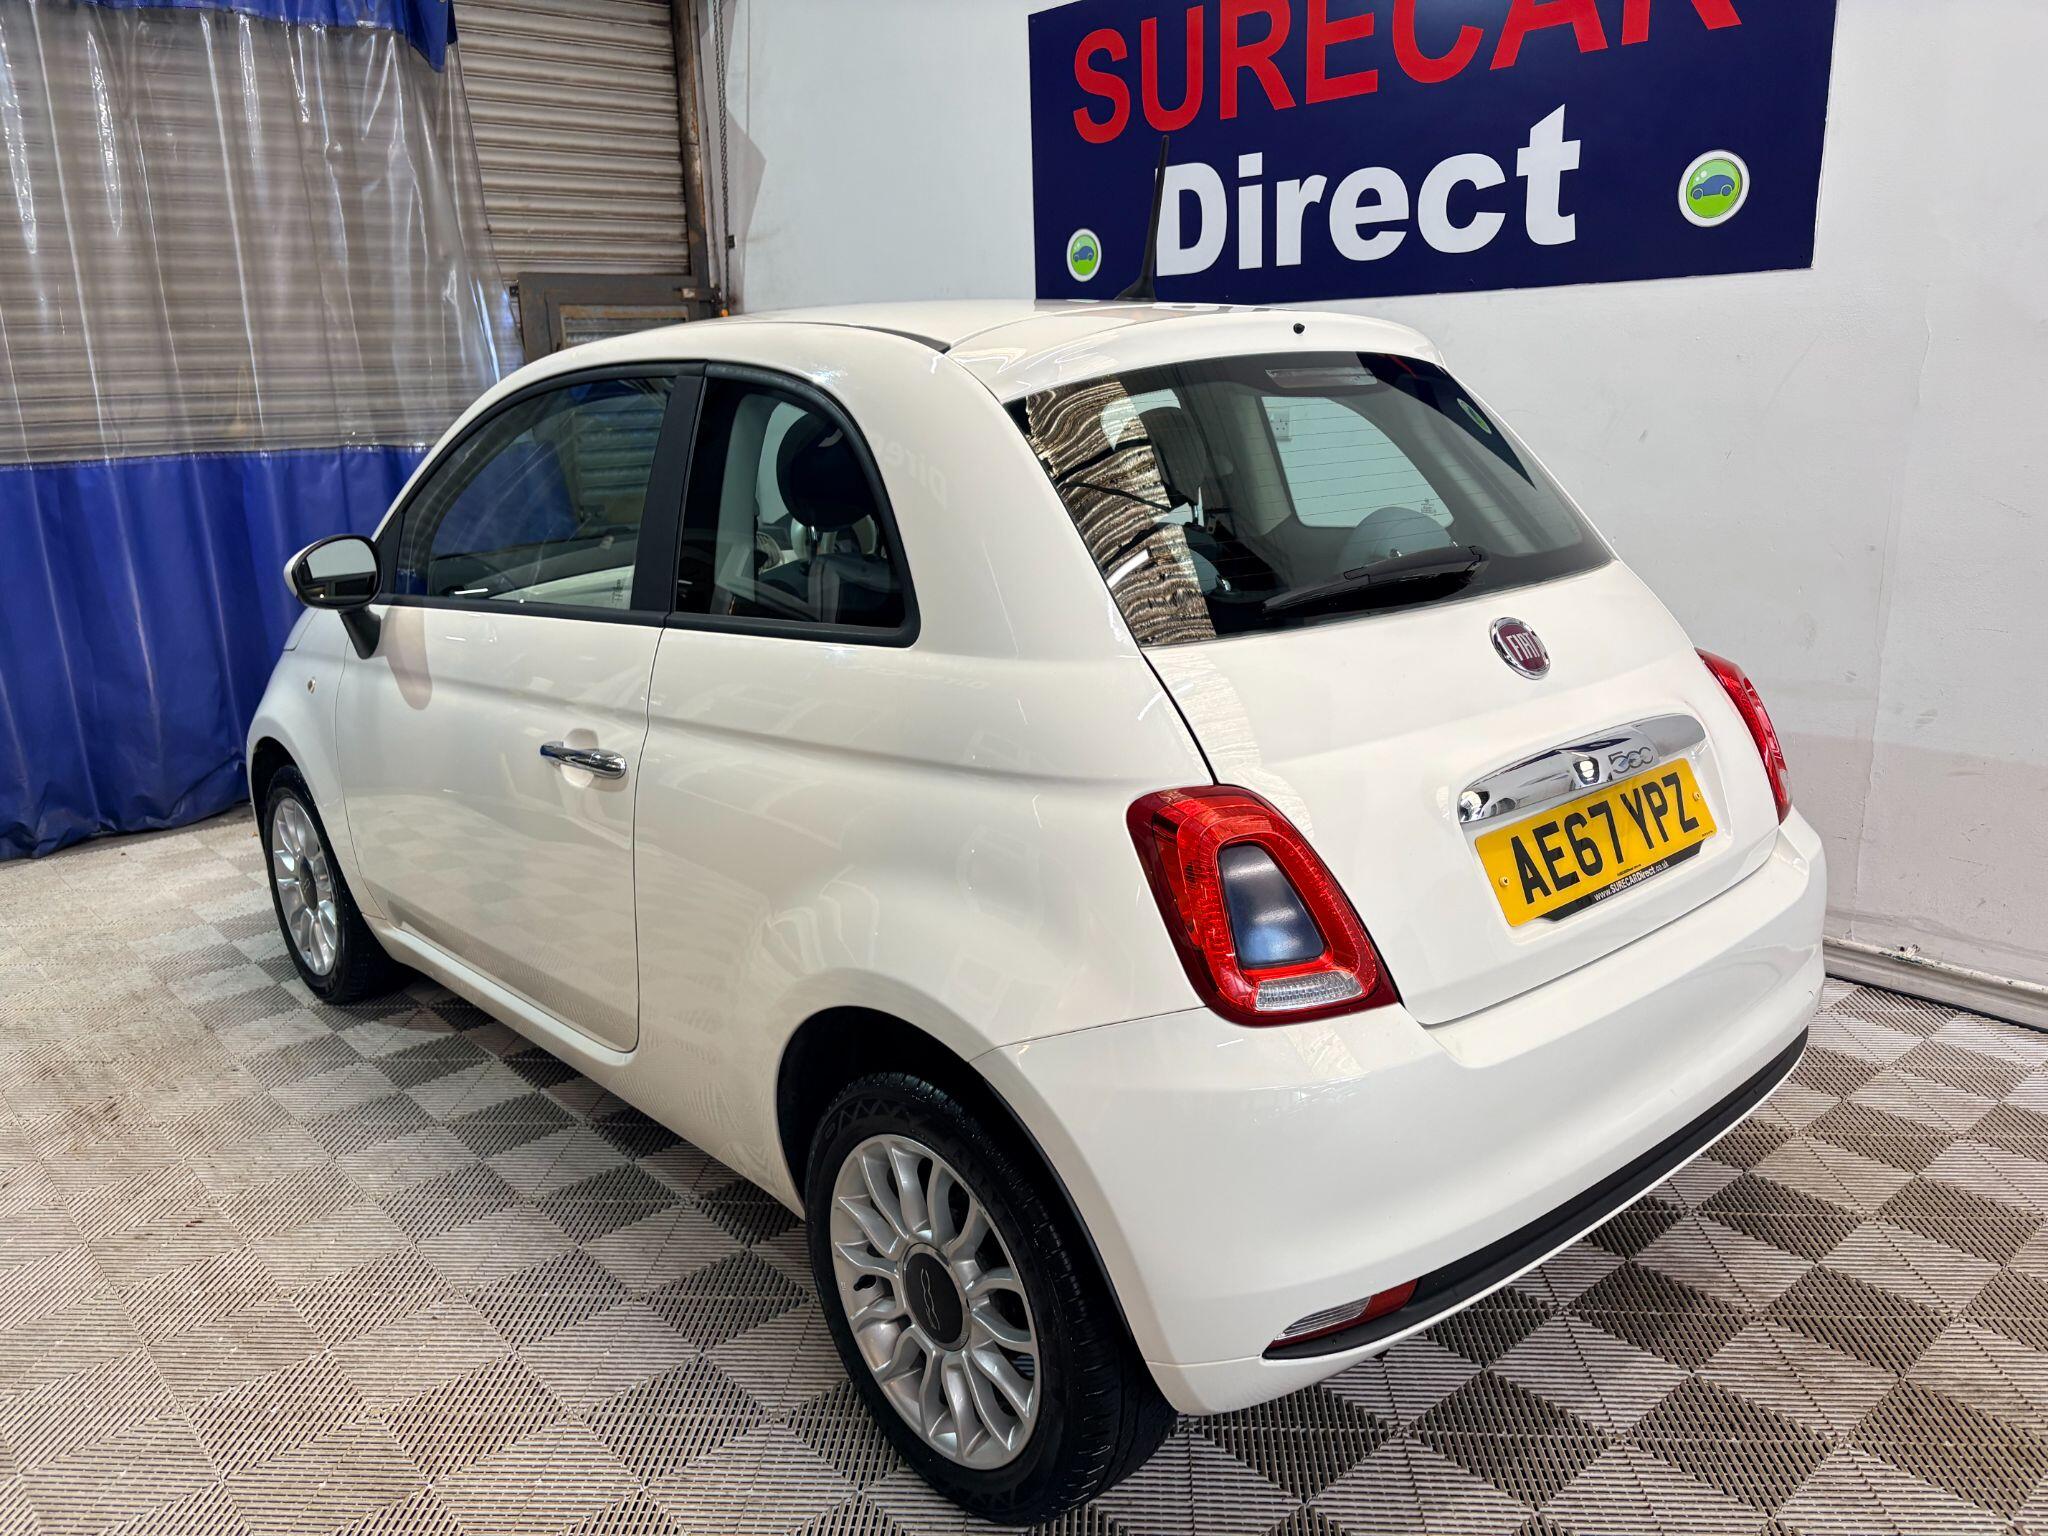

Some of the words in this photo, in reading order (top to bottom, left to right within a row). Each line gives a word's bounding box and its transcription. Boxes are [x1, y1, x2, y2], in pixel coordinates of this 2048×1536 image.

[1073, 0, 1742, 143] SURECA
[1156, 103, 1582, 277] Direct
[1505, 632, 1541, 661] FIAT
[1608, 746, 1654, 774] 500
[1511, 800, 1624, 904] AE67
[1620, 772, 1699, 850] YPZ
